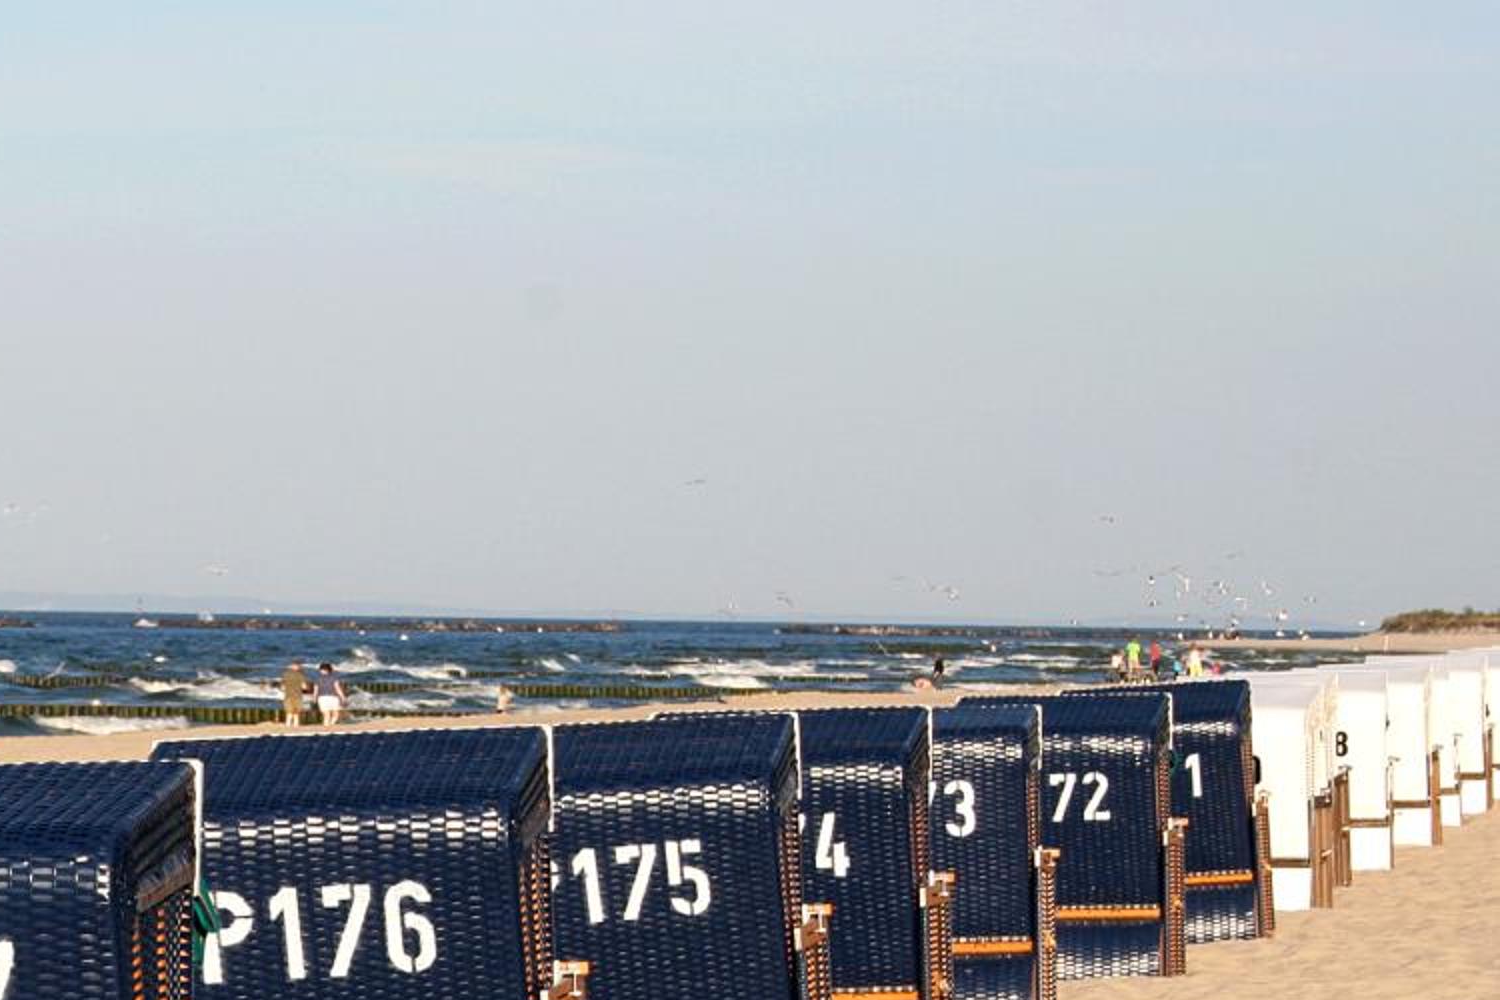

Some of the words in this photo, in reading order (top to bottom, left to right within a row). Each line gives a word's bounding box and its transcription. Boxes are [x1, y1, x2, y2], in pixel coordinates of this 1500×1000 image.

[1049, 771, 1111, 823] 72
[1185, 753, 1202, 797] 1
[798, 812, 850, 877] 4
[550, 839, 711, 924] 175
[202, 880, 437, 985] P176
